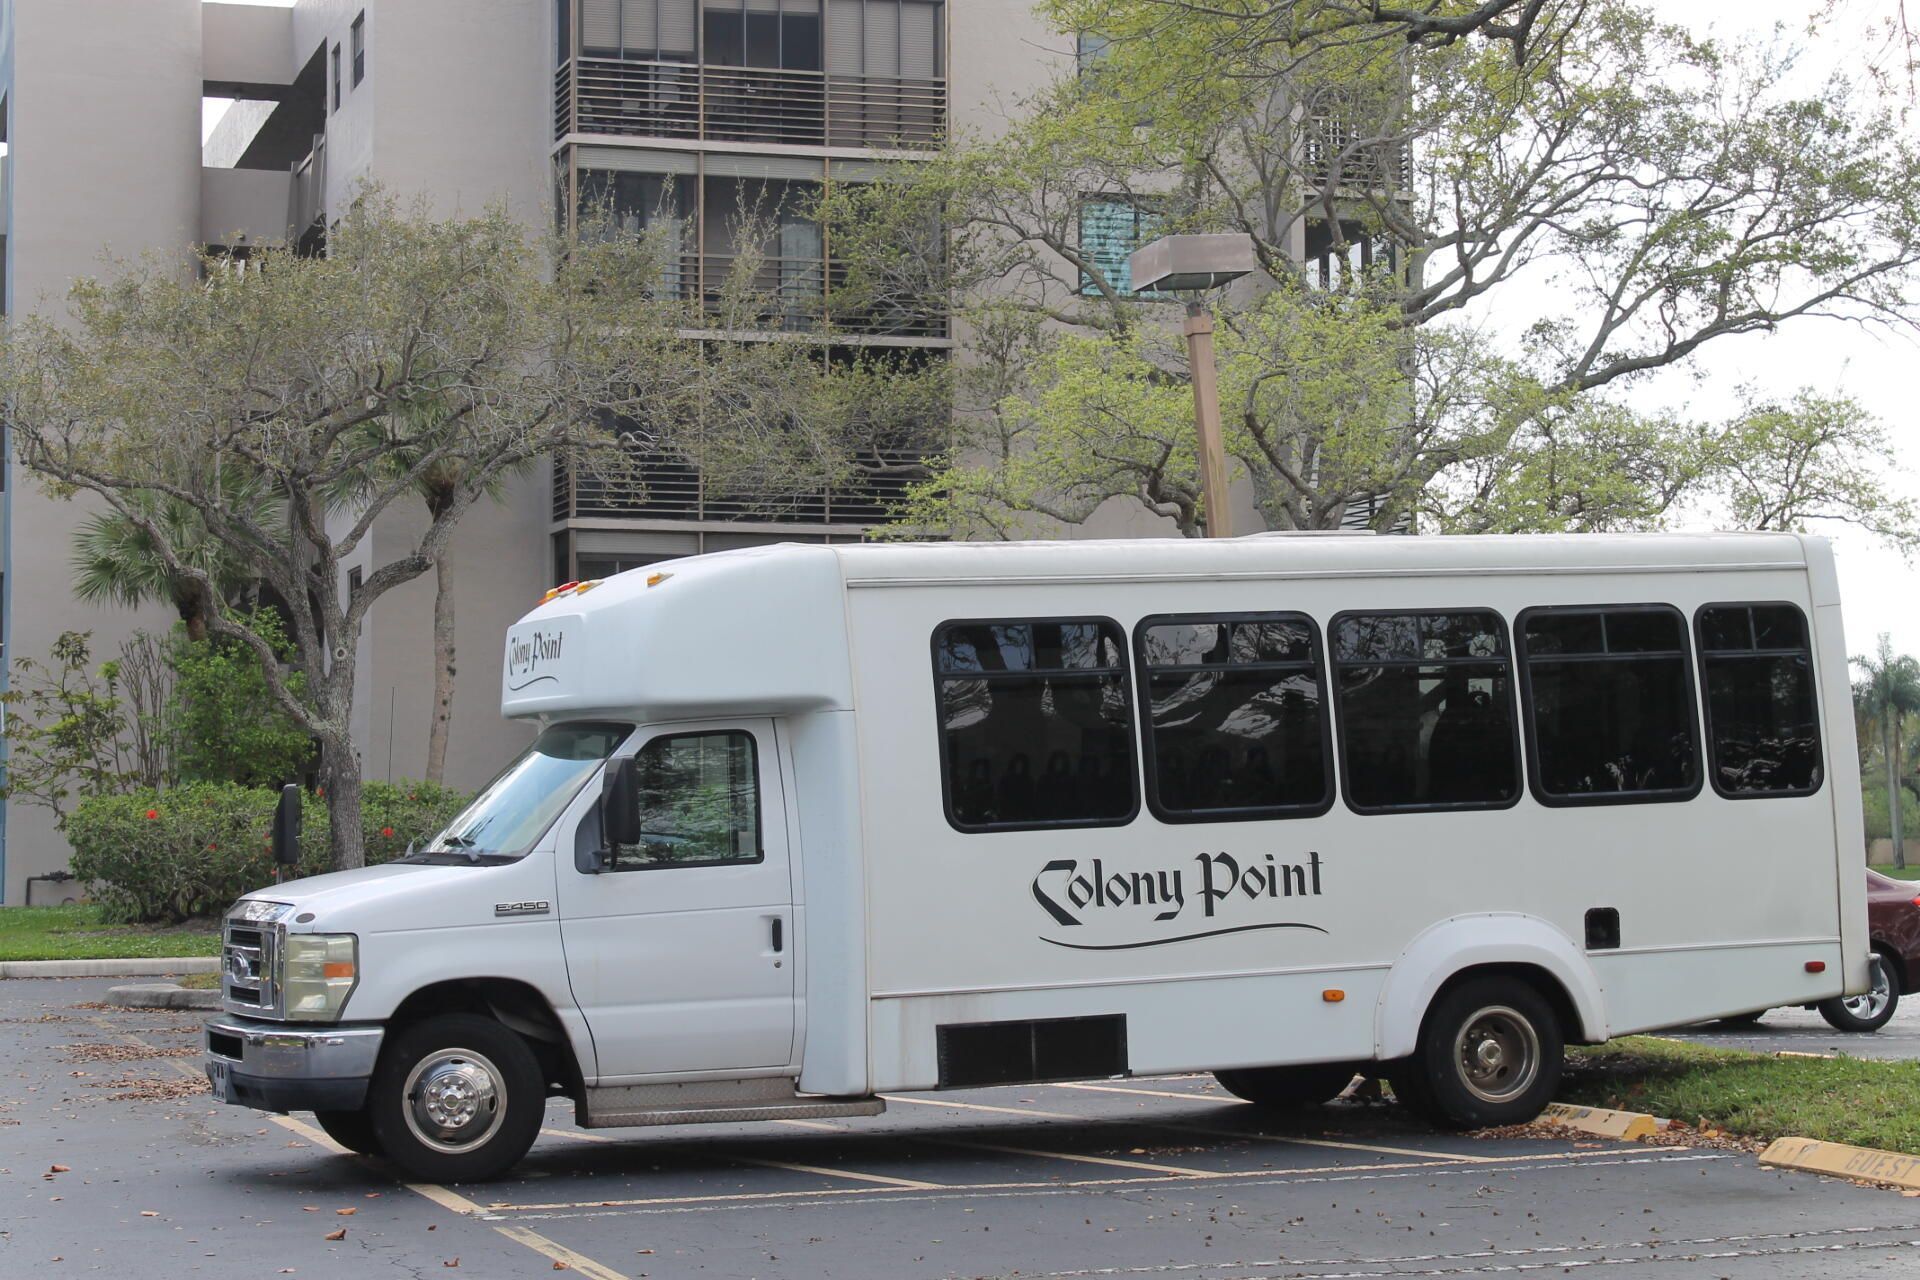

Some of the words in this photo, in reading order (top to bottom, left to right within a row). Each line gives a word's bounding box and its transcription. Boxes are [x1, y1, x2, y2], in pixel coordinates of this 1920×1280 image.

[508, 635, 531, 677] Colony
[531, 631, 563, 672] Point
[1032, 858, 1185, 927] Colony
[1195, 851, 1325, 918] Point
[1844, 1150, 1920, 1179] GUEST
